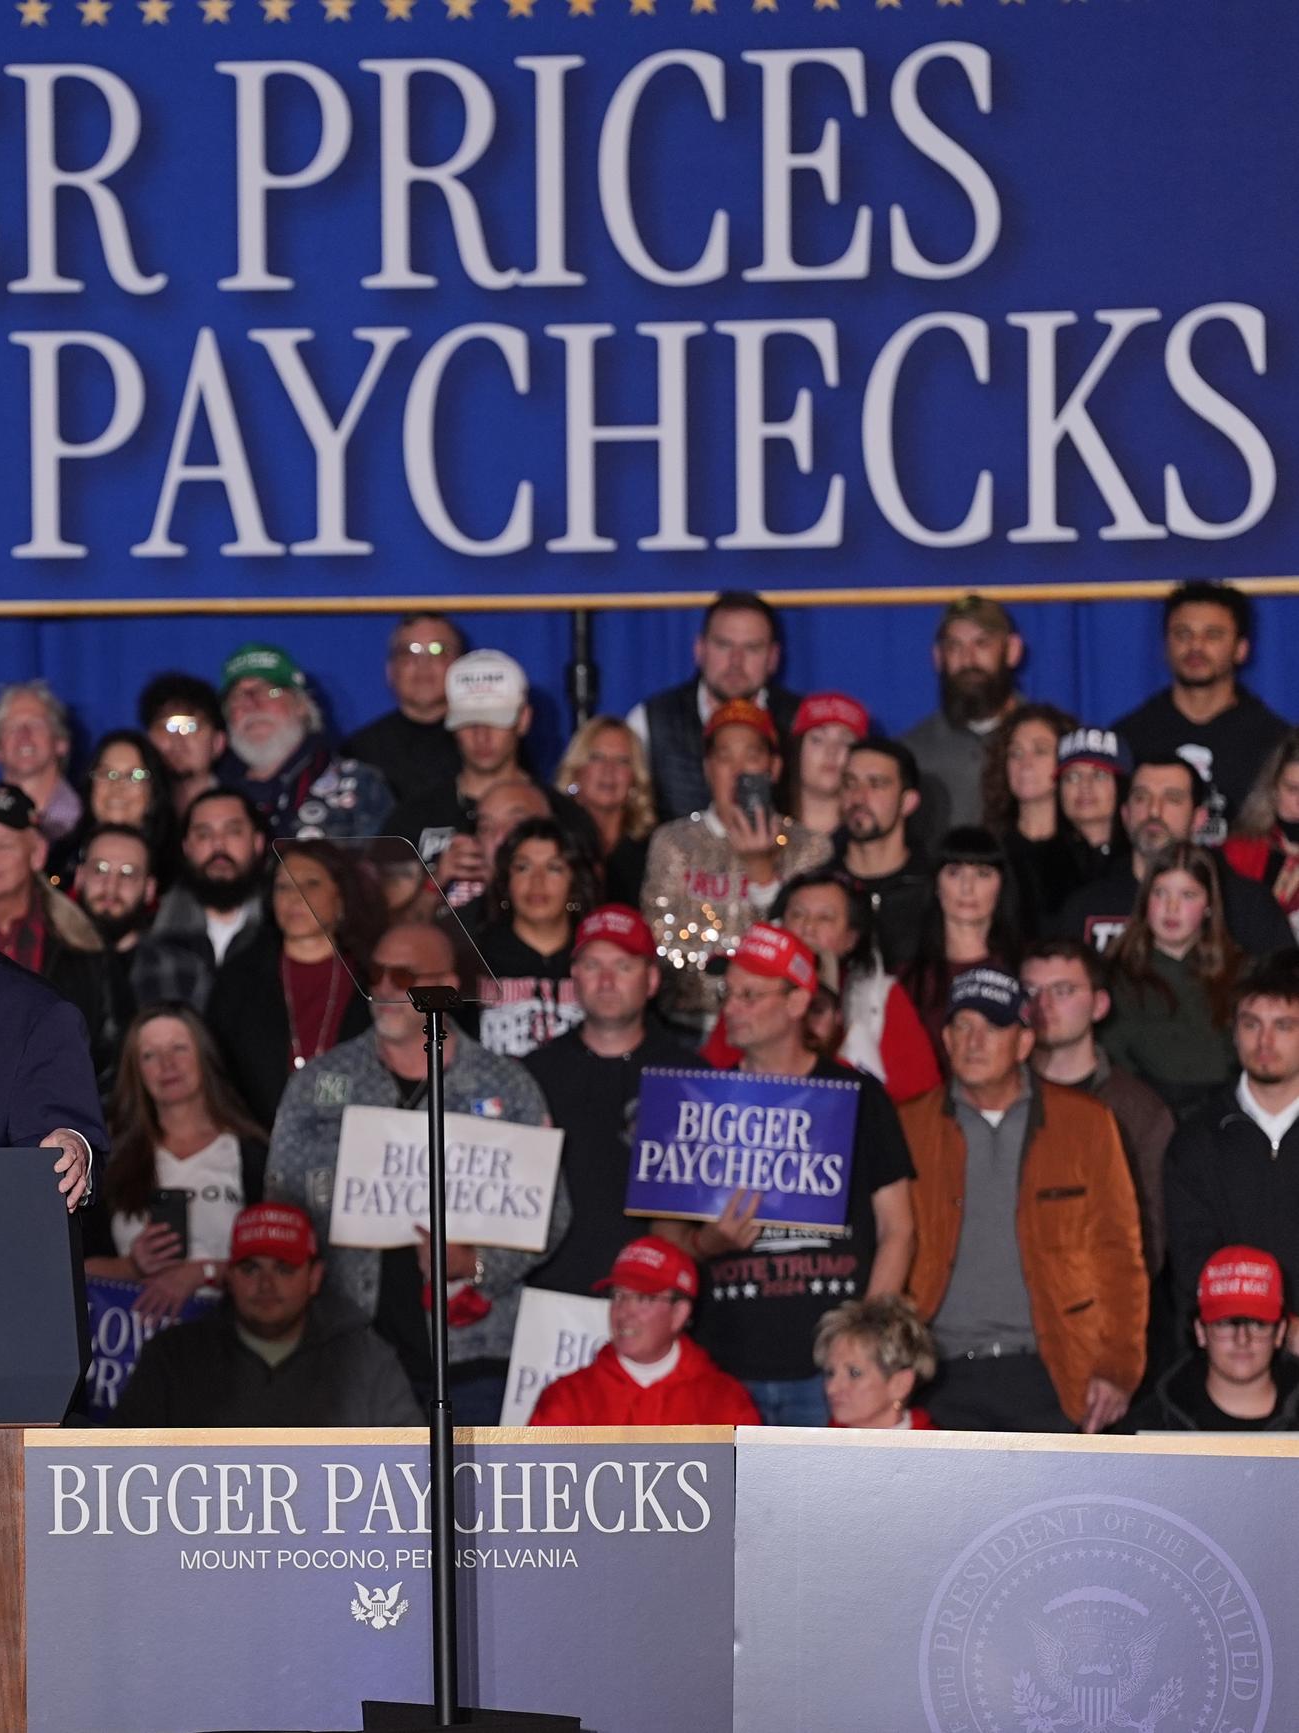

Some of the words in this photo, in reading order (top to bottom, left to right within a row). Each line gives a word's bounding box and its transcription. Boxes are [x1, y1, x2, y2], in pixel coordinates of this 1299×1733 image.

[214, 41, 1001, 291] PRICES
[9, 302, 1277, 559] PAYCHECKS
[675, 1100, 813, 1152] BIGGER
[635, 1139, 844, 1197] PAYCHECKS
[342, 1176, 543, 1221] PAYCECKS
[771, 1253, 858, 1279] TRUMP
[47, 1462, 307, 1536] BIGGER
[320, 1460, 712, 1535] PAYCHECKS
[180, 1550, 273, 1570] MOUNT
[277, 1549, 390, 1573] POCONO,
[933, 1506, 1091, 1655] PRESIDENT
[1103, 1511, 1138, 1534] OF
[1143, 1521, 1190, 1560] THE
[1190, 1552, 1261, 1703] UNITED
